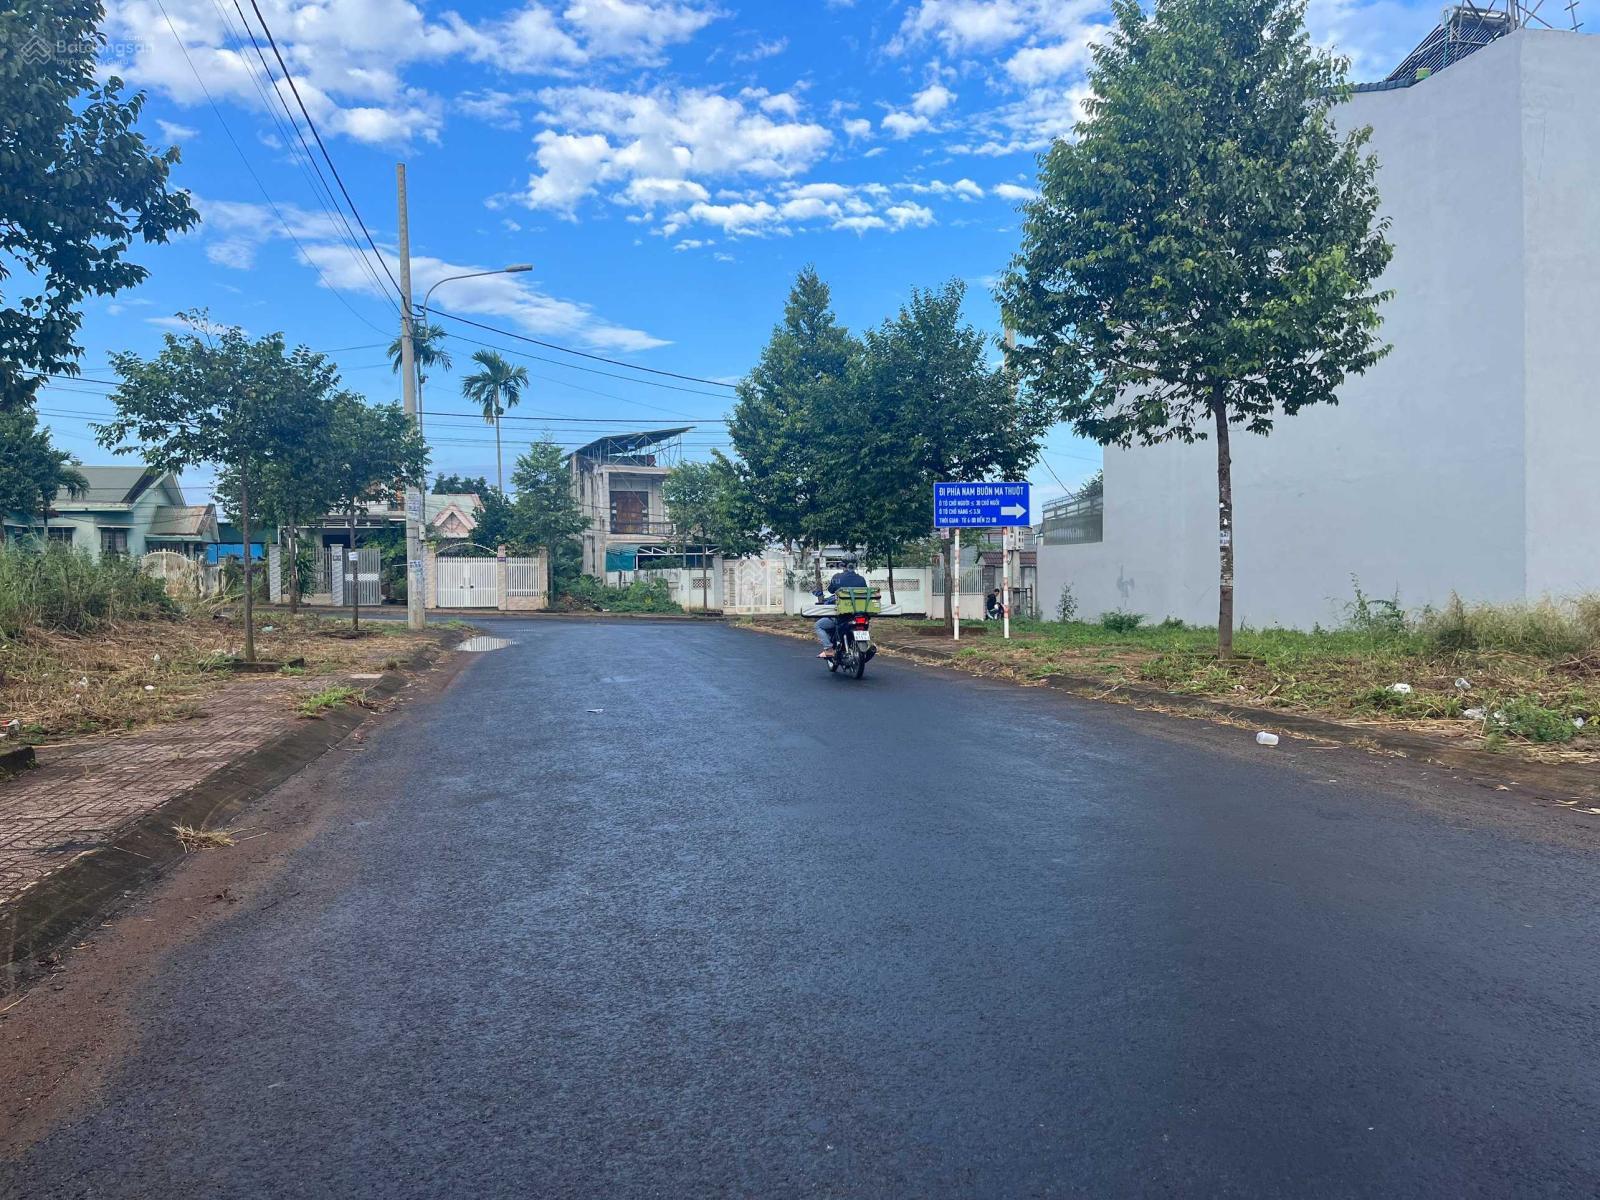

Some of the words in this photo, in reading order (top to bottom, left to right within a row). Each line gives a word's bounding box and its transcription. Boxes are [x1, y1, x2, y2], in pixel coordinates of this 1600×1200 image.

[939, 487, 946, 496] ĐI
[947, 485, 960, 496] PHÍA
[961, 487, 975, 496] NAM
[976, 485, 993, 496] BUÔN
[994, 486, 1004, 496] MA
